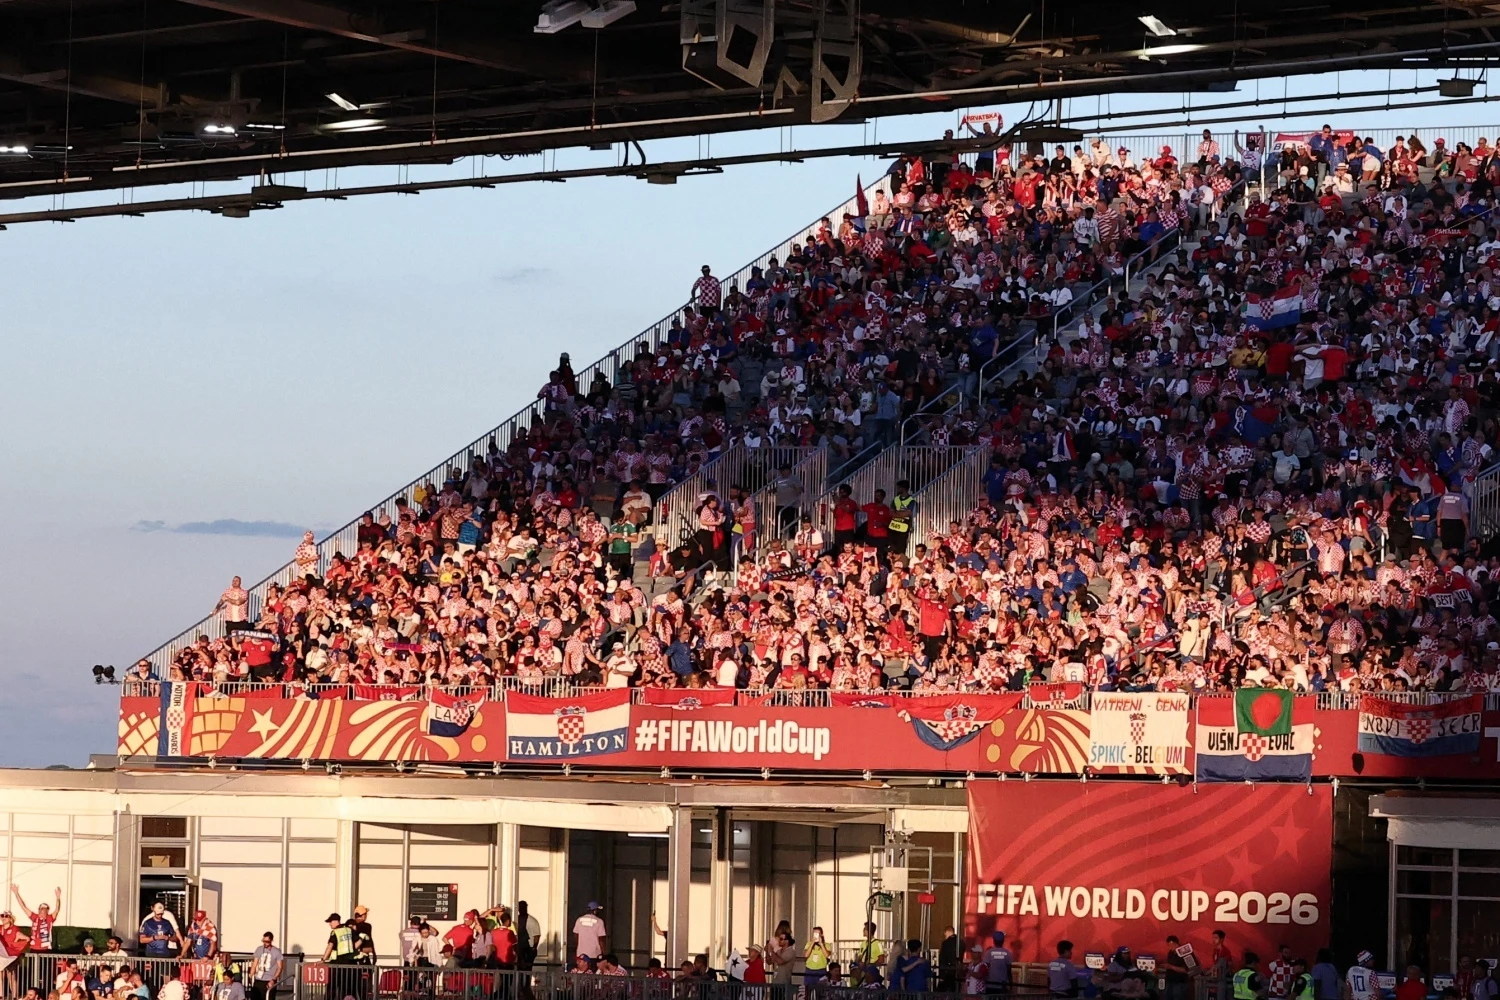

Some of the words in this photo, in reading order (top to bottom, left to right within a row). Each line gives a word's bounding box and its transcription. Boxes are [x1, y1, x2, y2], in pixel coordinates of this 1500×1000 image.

[1093, 695, 1143, 713] VATRENI
[1155, 695, 1188, 713] GENK
[510, 733, 626, 757] HAMILTON
[634, 718, 831, 761] #FIFAWorldCup
[1134, 745, 1184, 765] BELGIUM
[976, 883, 1041, 917] FIFA
[1043, 885, 1145, 920] WORLD
[1151, 888, 1210, 923] CUP
[1213, 890, 1320, 926] 2026
[194, 963, 213, 979] 112
[306, 966, 326, 982] 113
[1352, 975, 1366, 992] 10
